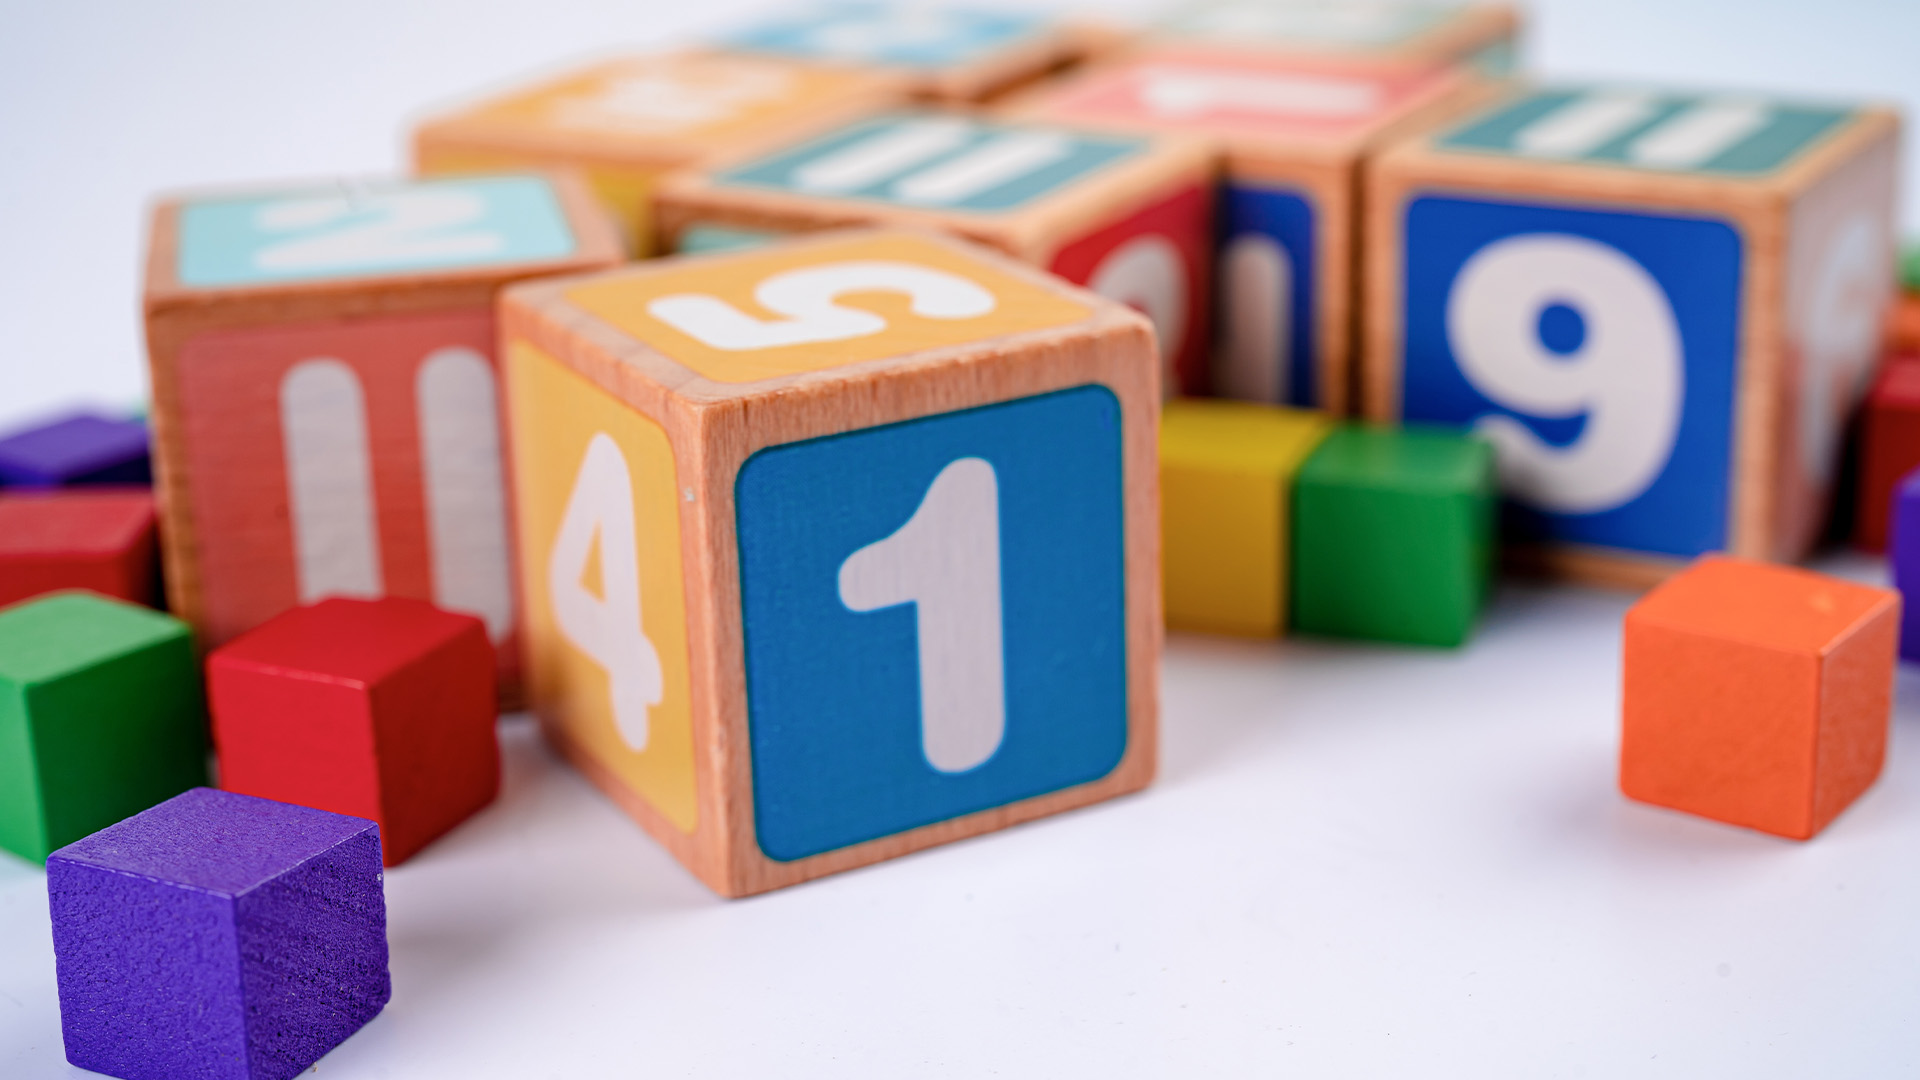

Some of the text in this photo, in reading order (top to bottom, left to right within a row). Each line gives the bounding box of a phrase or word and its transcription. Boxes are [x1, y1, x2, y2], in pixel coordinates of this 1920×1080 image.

[649, 262, 994, 349] 5
[1450, 235, 1684, 512] 9
[550, 433, 662, 751] 4
[838, 456, 1005, 773] 1
